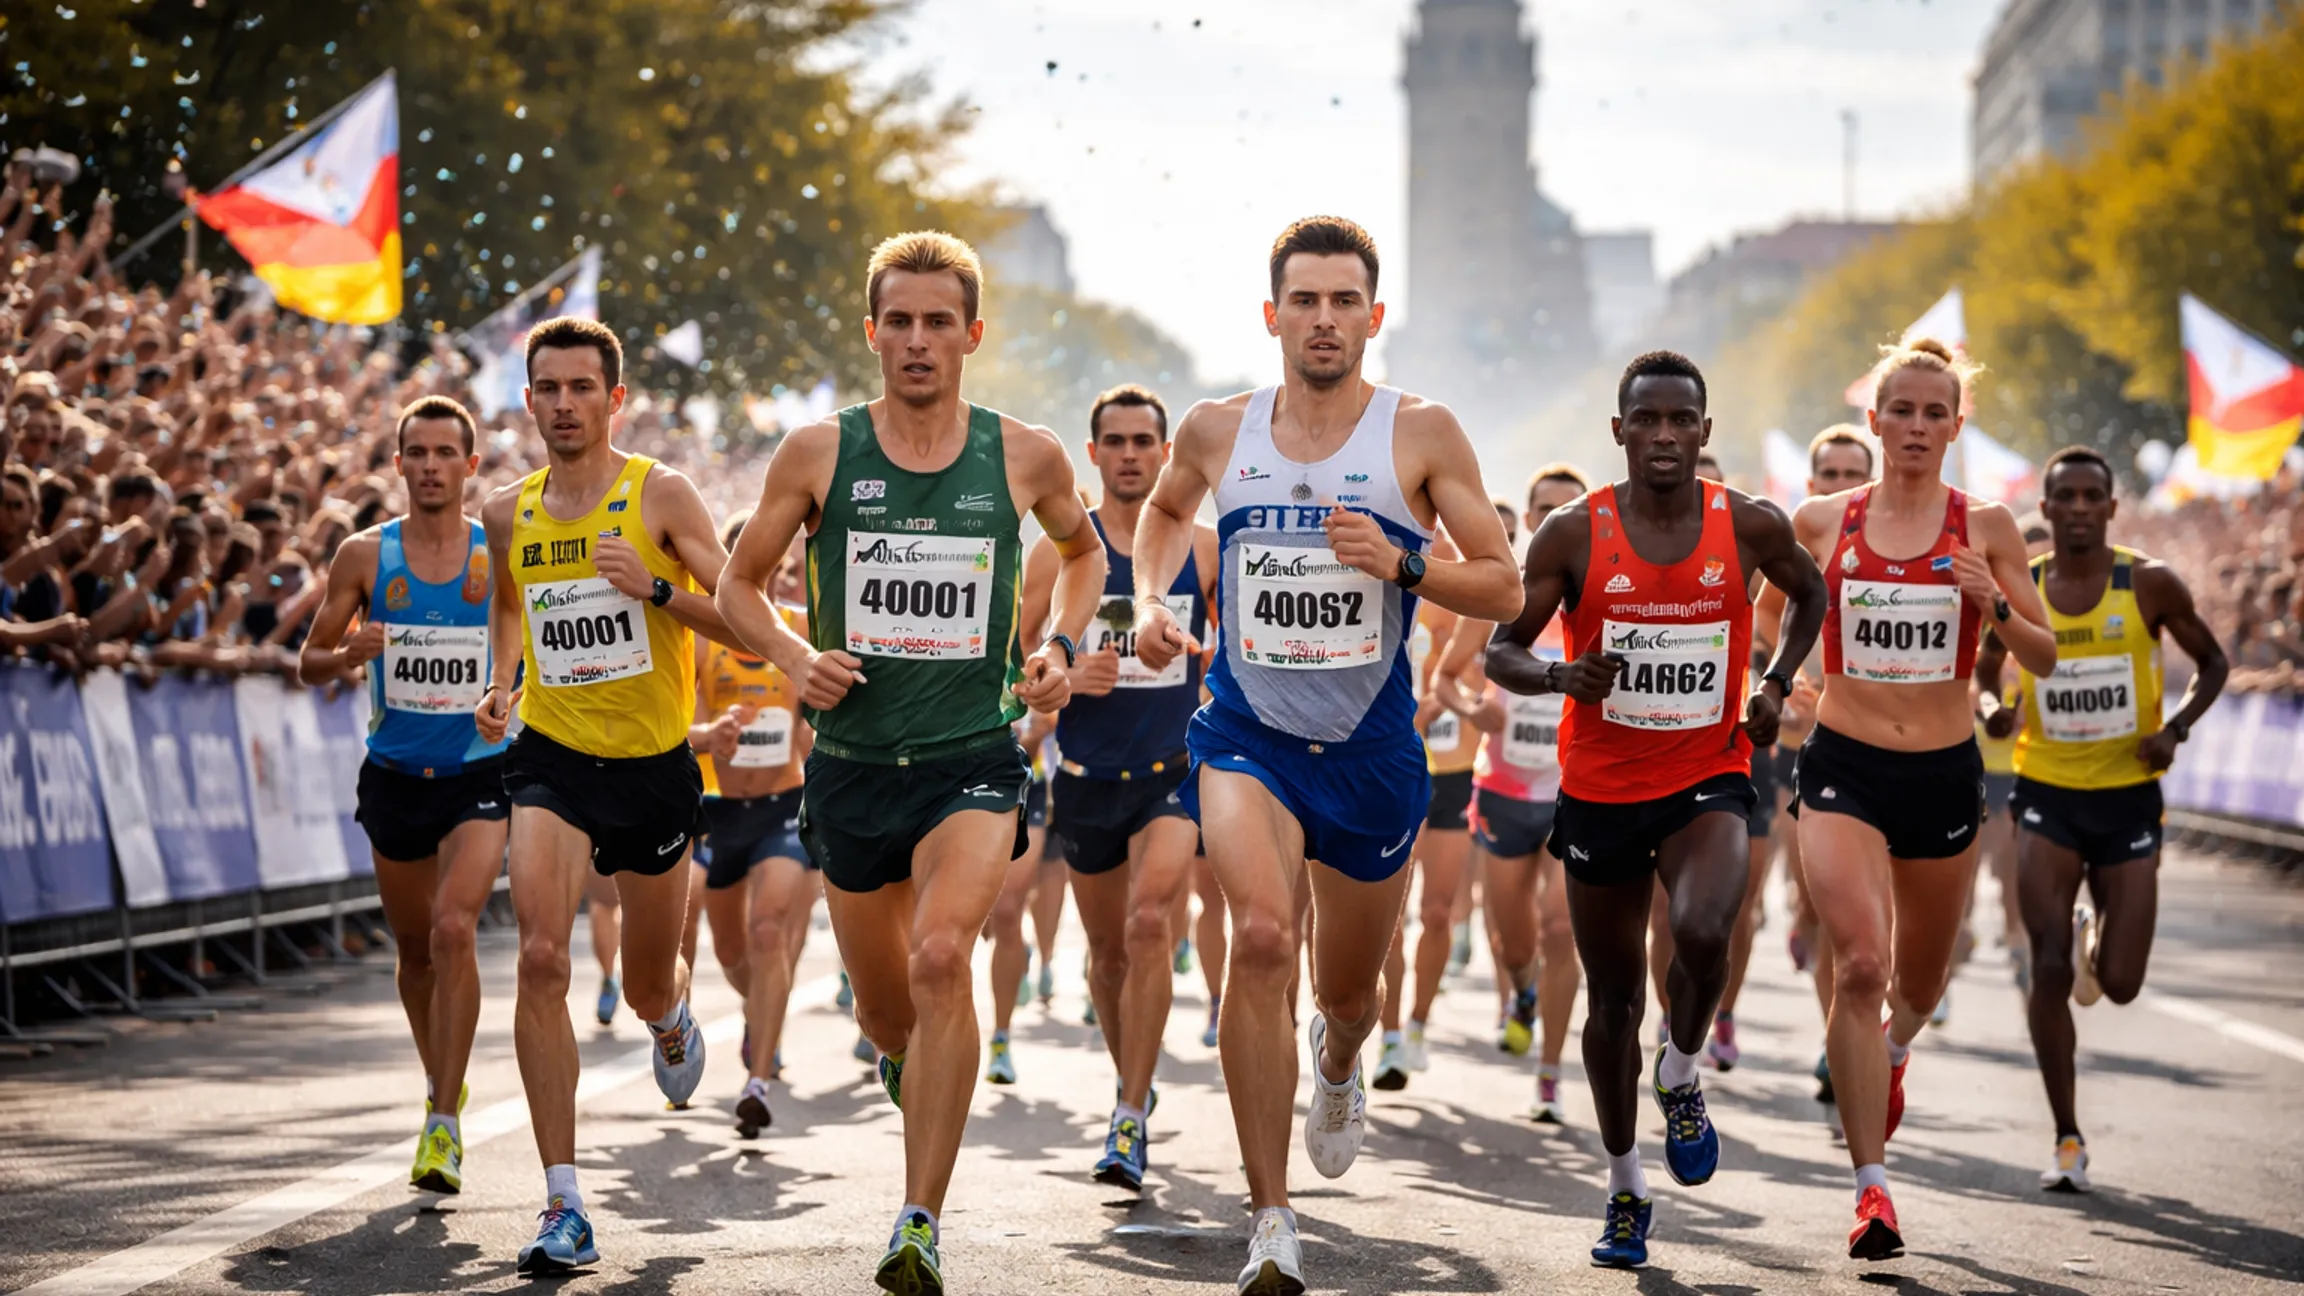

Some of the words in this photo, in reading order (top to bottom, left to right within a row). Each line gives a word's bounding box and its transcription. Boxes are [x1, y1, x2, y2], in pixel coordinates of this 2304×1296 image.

[860, 578, 976, 618] 40001
[542, 610, 633, 651] 40001
[1855, 618, 1947, 650] 40012
